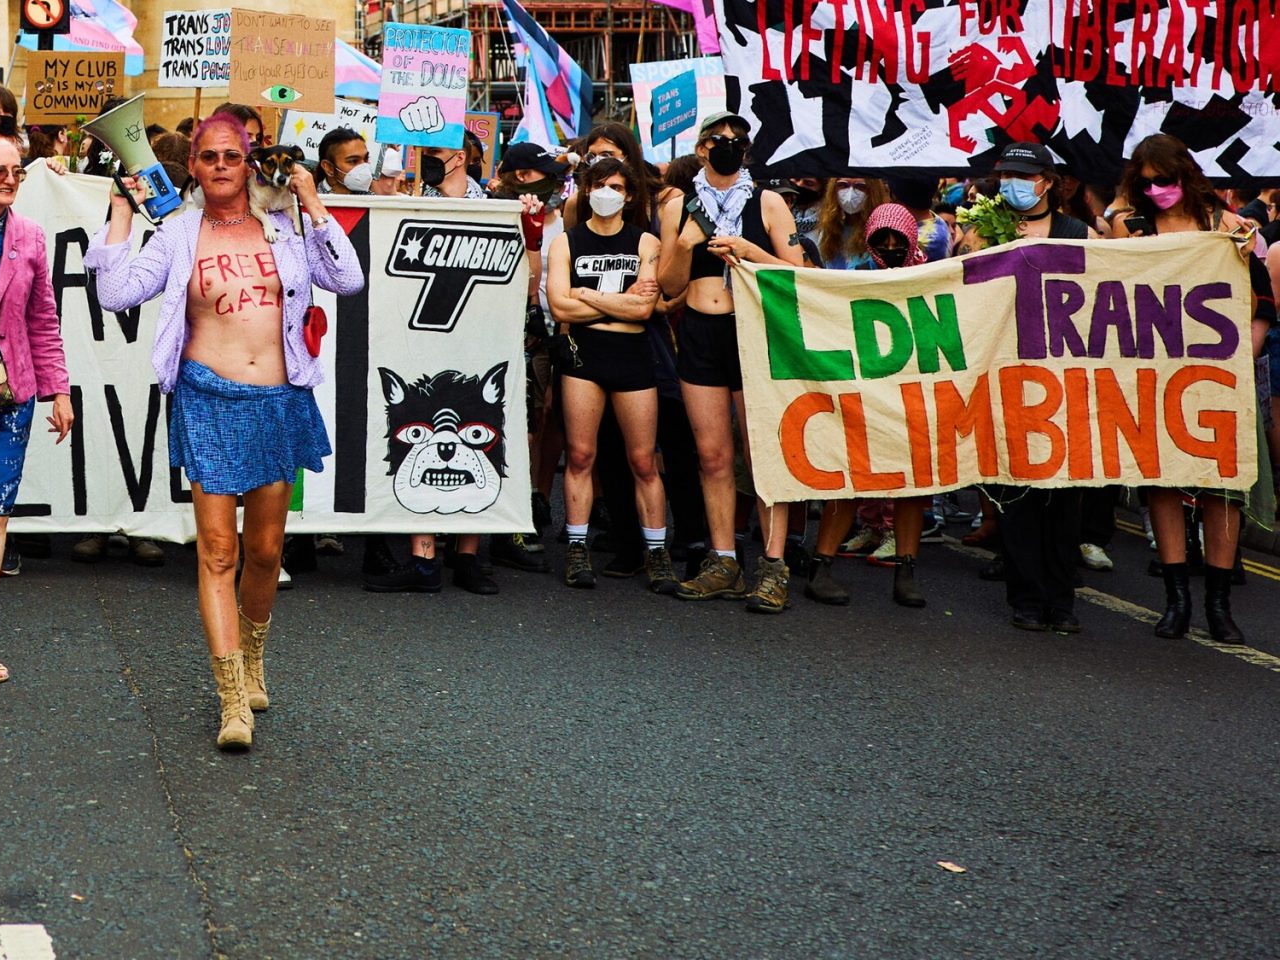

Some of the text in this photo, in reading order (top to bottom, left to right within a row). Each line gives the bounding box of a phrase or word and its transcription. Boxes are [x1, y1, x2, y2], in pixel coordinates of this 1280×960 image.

[166, 13, 232, 36] TRANS JO
[298, 18, 311, 31] TO
[315, 20, 332, 32] SEE
[74, 37, 89, 46] AND
[92, 40, 109, 49] FIND
[164, 37, 232, 57] TRANS LOV
[384, 27, 468, 58] PROTECTOR
[45, 59, 116, 78] MY CLUB
[162, 59, 198, 79] TRANS
[392, 55, 414, 69] OF
[390, 61, 467, 90] THE DOLLS
[58, 81, 94, 91] IS MY
[33, 94, 117, 110] COMMUNIT
[658, 88, 680, 104] TRANS
[340, 106, 360, 117] NOT
[658, 99, 681, 116] JOY IS
[312, 120, 327, 131] Act
[658, 107, 696, 133] RESISTANCE
[306, 137, 320, 149] Rev
[423, 234, 519, 272] CLIMBING
[592, 258, 637, 272] CLIMBING
[198, 252, 278, 298] FREE
[756, 244, 1239, 382] LDN TRANS
[779, 365, 1238, 492] CLIMBING
